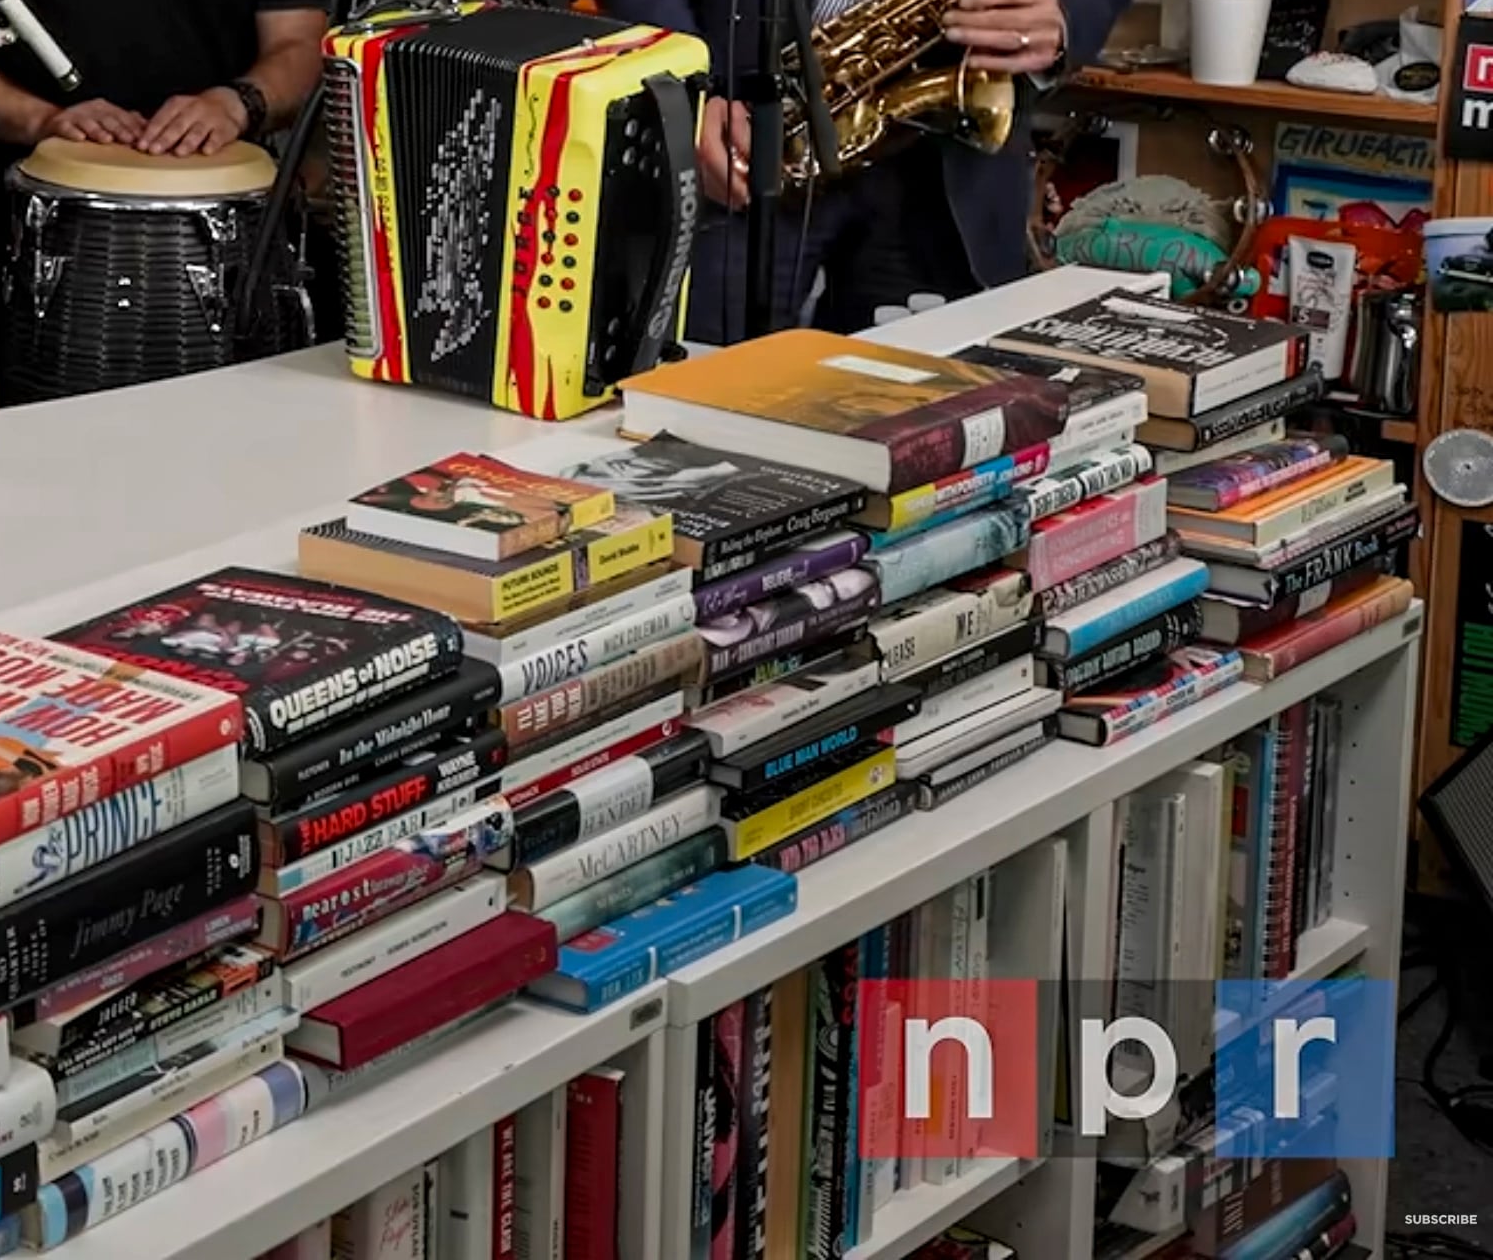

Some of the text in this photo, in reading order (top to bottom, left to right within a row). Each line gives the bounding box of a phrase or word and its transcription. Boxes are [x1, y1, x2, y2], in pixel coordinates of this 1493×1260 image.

[665, 170, 700, 302] HOHNER
[812, 500, 850, 524] Ferguson
[501, 575, 531, 592] FUTURE
[532, 562, 560, 582] SOUNDS
[1285, 574, 1303, 592] The
[1304, 539, 1352, 586] FRANK
[270, 632, 438, 729] QUEENS of NOISE
[521, 612, 671, 696] VOICES COLEMAN
[5, 704, 131, 747] HOW
[40, 674, 185, 724] MADE
[340, 748, 353, 766] In
[354, 739, 374, 760] the
[375, 715, 421, 748] Midnight
[765, 725, 860, 780] BLUE MAN WORLD
[63, 779, 162, 841] PRINCE
[312, 750, 476, 845] HARD STUFF WAYNE
[582, 791, 652, 836] HANDEL
[577, 810, 683, 882] McCARTNEY
[71, 881, 184, 957] Jimmy Page
